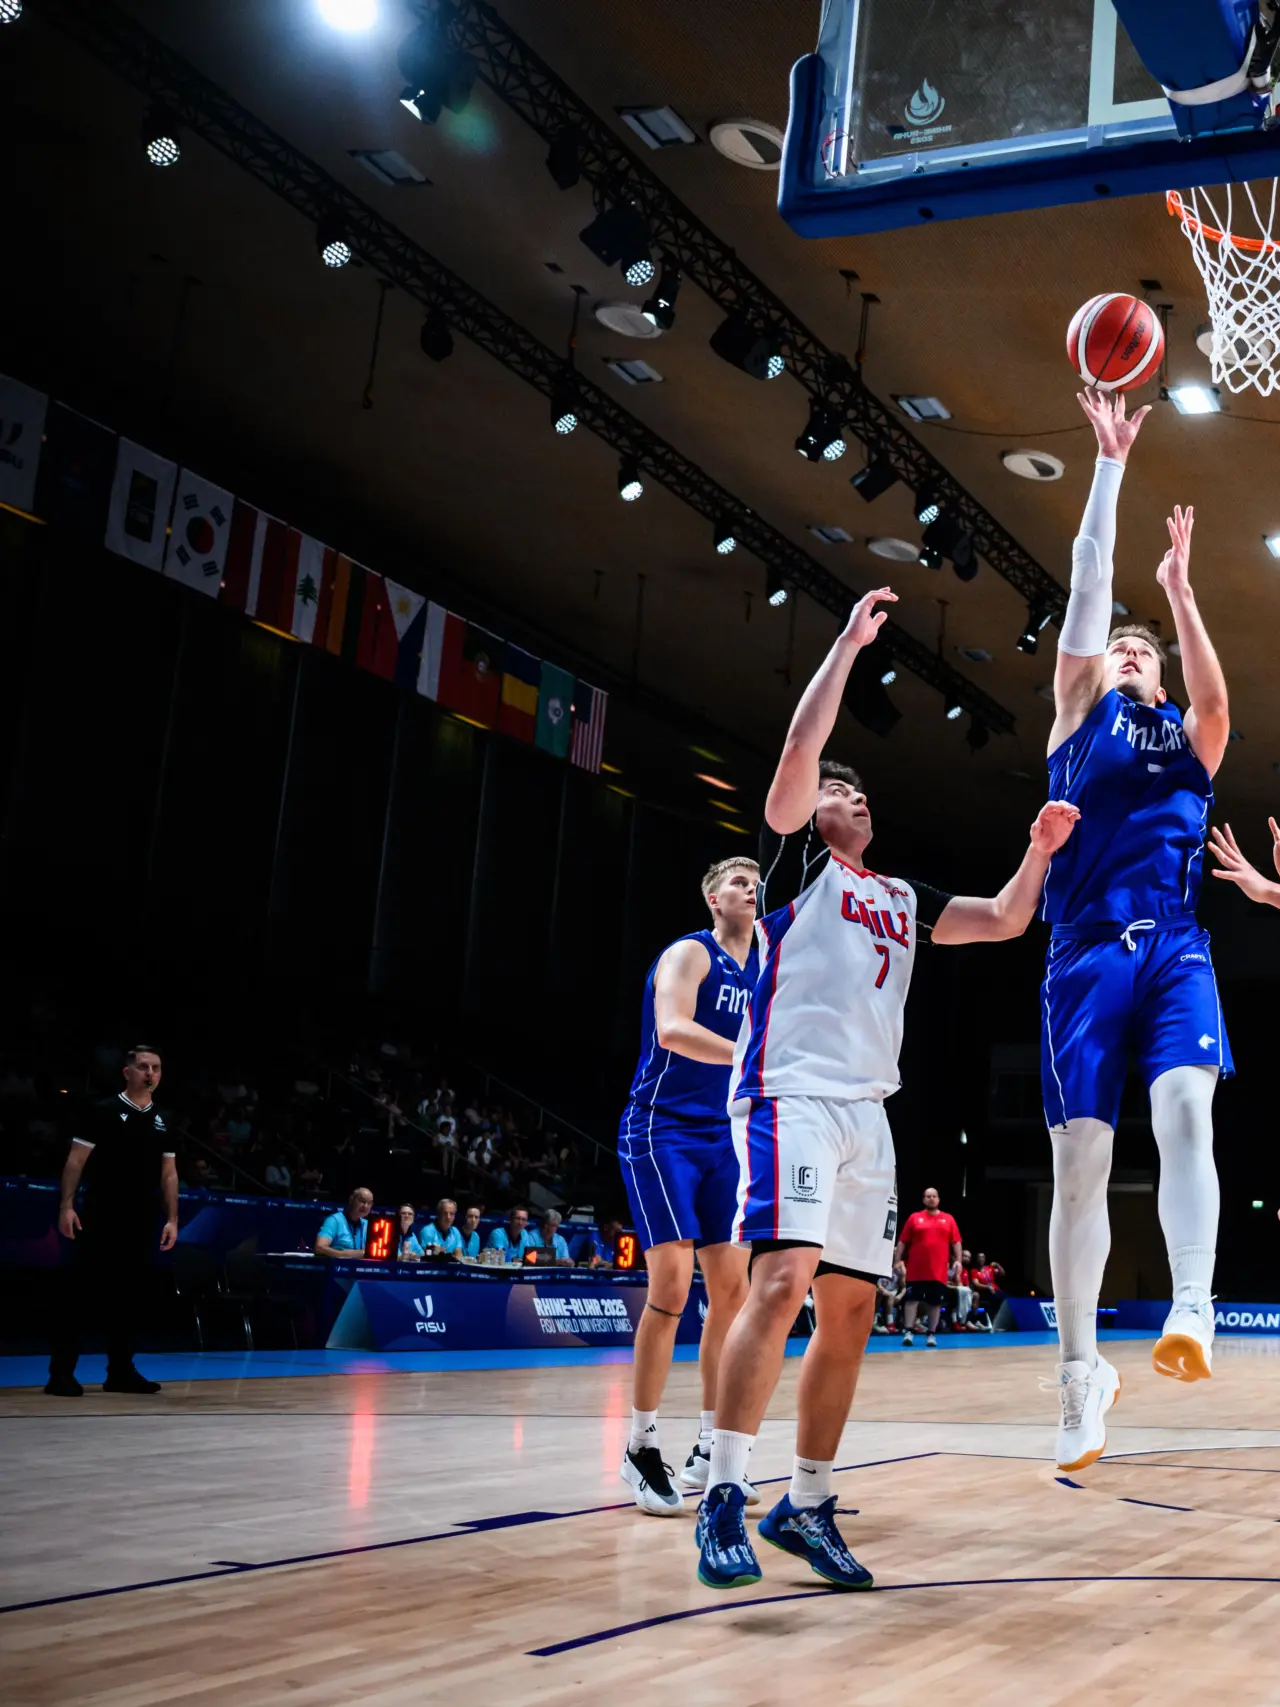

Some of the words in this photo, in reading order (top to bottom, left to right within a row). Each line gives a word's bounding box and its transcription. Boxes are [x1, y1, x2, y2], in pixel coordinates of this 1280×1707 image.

[873, 943, 891, 990] 7
[715, 984, 753, 1016] FIN
[372, 1219, 391, 1257] 2
[617, 1235, 635, 1268] 3
[533, 1297, 602, 1317] RHINE-RUHR
[601, 1298, 628, 1316] 2025
[415, 1321, 447, 1333] FISU
[540, 1318, 556, 1333] FISU
[555, 1318, 580, 1333] WORLD
[581, 1318, 614, 1333] UNIVERSITY
[614, 1318, 633, 1333] GAMES
